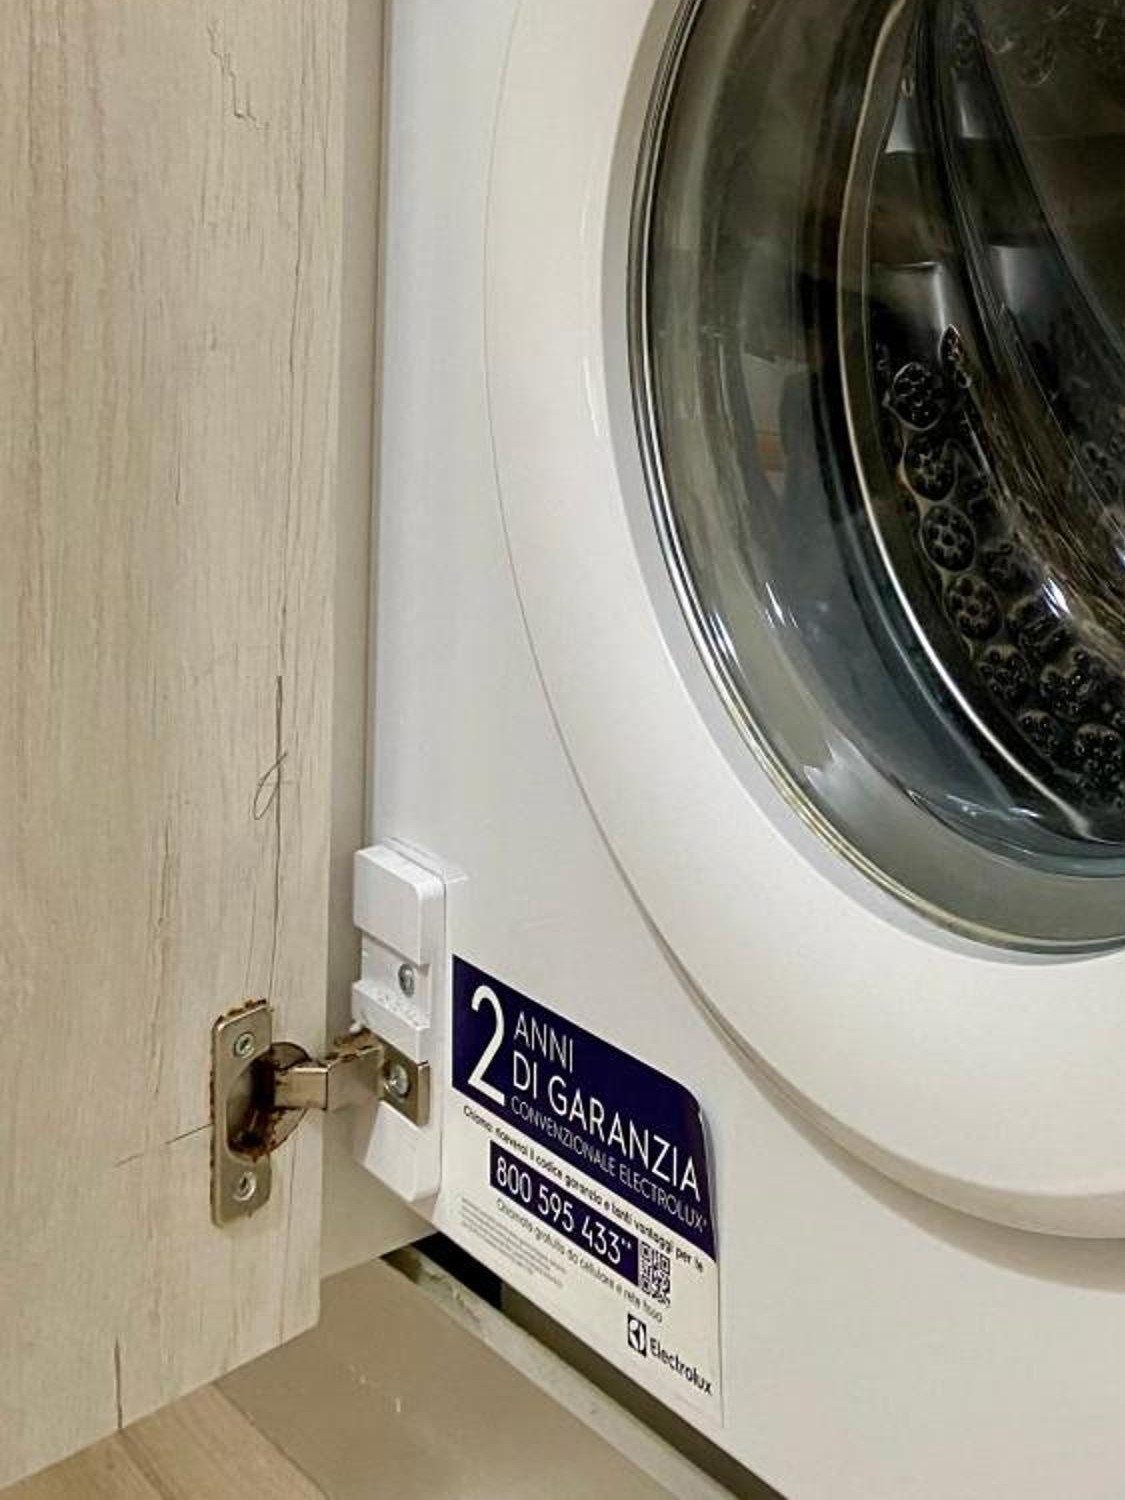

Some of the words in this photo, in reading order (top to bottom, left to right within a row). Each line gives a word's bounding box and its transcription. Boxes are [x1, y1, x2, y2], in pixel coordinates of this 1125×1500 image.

[466, 984, 506, 1108] 2
[513, 1010, 575, 1075] ANNI
[511, 1095, 616, 1177] CONVENZIONALE
[512, 1050, 539, 1100] DI
[547, 1074, 702, 1202] GARANZIA
[496, 1155, 533, 1203] 800
[537, 1183, 575, 1233] 595
[649, 1336, 713, 1397] Electrolux
